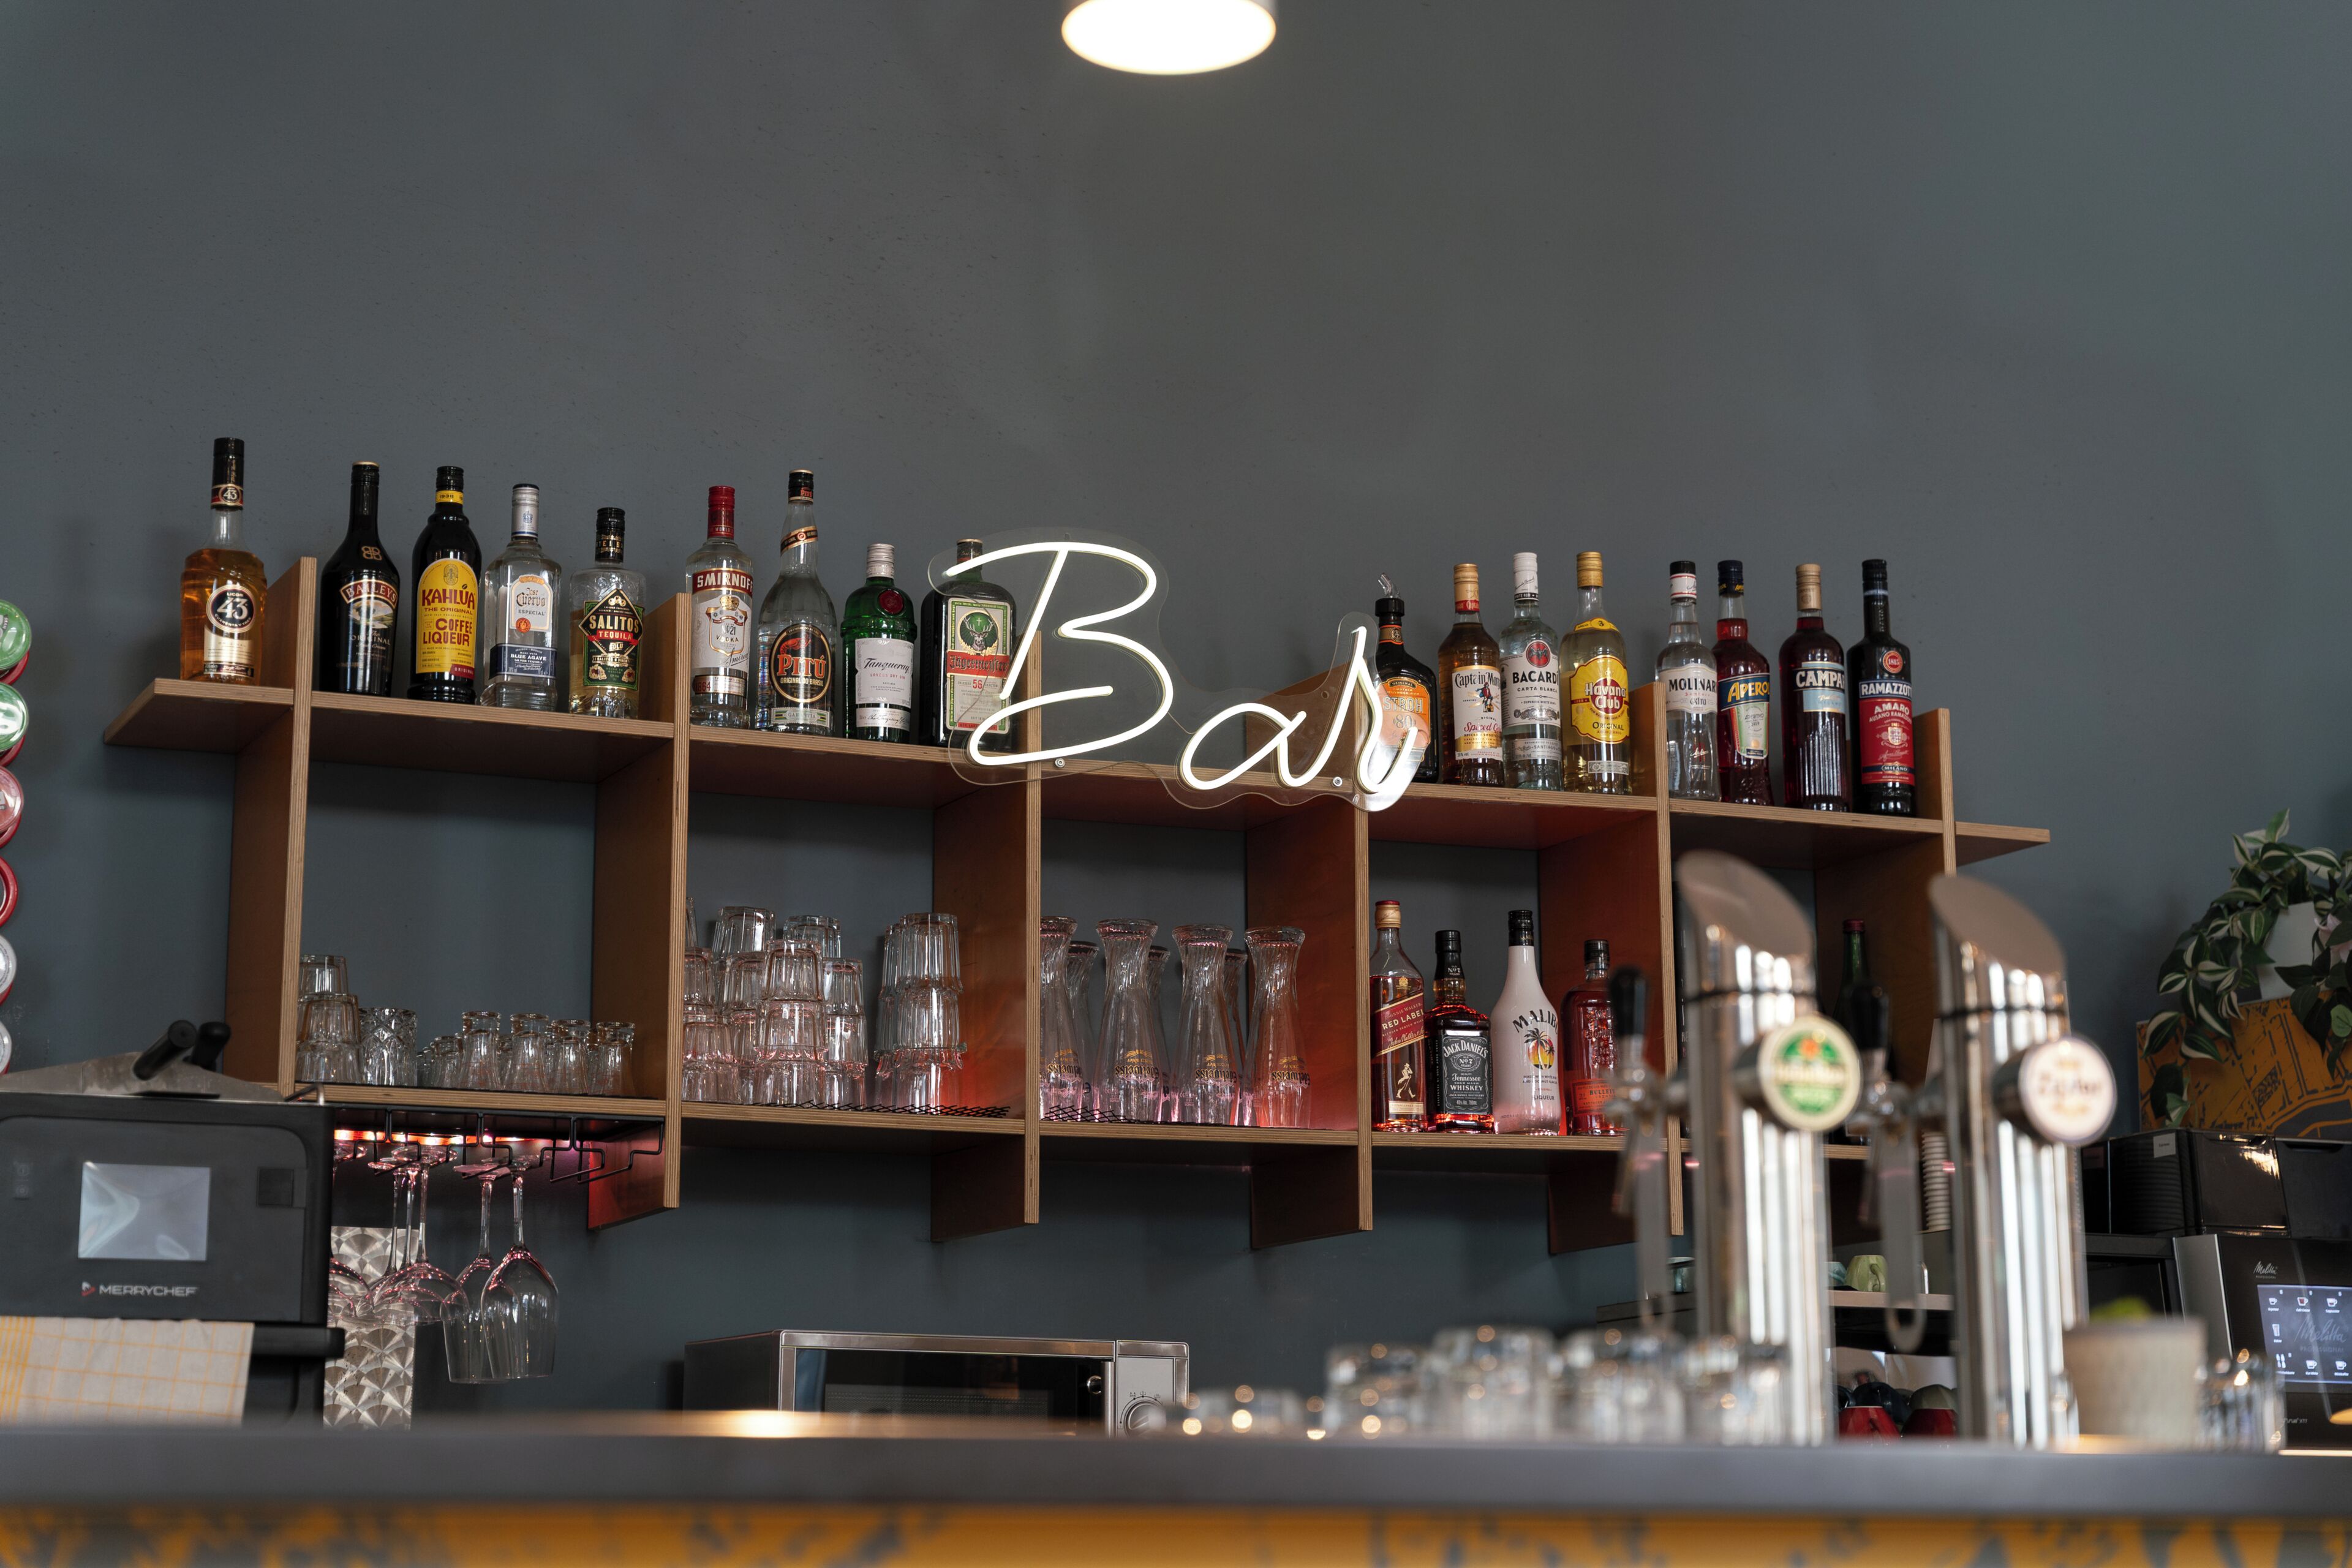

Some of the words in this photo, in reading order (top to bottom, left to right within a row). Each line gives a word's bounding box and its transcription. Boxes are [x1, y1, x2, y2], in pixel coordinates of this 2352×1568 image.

[223, 489, 237, 500] 43
[697, 572, 753, 592] SMIRNOFF
[345, 583, 398, 603] BAILEYS
[421, 584, 475, 610] KAHLÚA
[516, 592, 545, 607] Cuervo
[217, 597, 248, 620] 43
[440, 607, 473, 616] ORIGINAL
[435, 618, 472, 635] COFFEE
[589, 615, 639, 633] SALITOS
[423, 631, 470, 647] LIQUEUR
[598, 631, 632, 640] TEQUILA
[777, 654, 826, 679] PITÚ
[864, 658, 911, 674] Tanqueray
[943, 541, 1417, 793] Bar
[695, 681, 711, 693] 1864
[809, 678, 824, 687] BRASIL
[973, 679, 982, 690] 56
[1455, 673, 1485, 688] Captain
[1585, 682, 1626, 698] Havana
[1383, 696, 1423, 714] STROH
[1595, 696, 1621, 709] Club
[1874, 703, 1910, 715] AMARO
[1396, 714, 1413, 729] 80
[1869, 711, 1890, 723] AUSANO
[1464, 722, 1492, 732] Spiced
[1593, 722, 1624, 731] ORIGINAL
[1385, 1009, 1403, 1019] JOHNNIE
[1404, 1002, 1421, 1012] WALKER
[1382, 1019, 1399, 1030] RED
[1401, 1009, 1424, 1023] LABEL
[1443, 1042, 1461, 1057] JACK
[1461, 1040, 1488, 1058] DANIEL'S
[1452, 1073, 1481, 1082] Tennessee
[2253, 1261, 2277, 1276] Melitta
[99, 1284, 198, 1297] MERRYCHEF
[2294, 1318, 2347, 1343] Melitta
